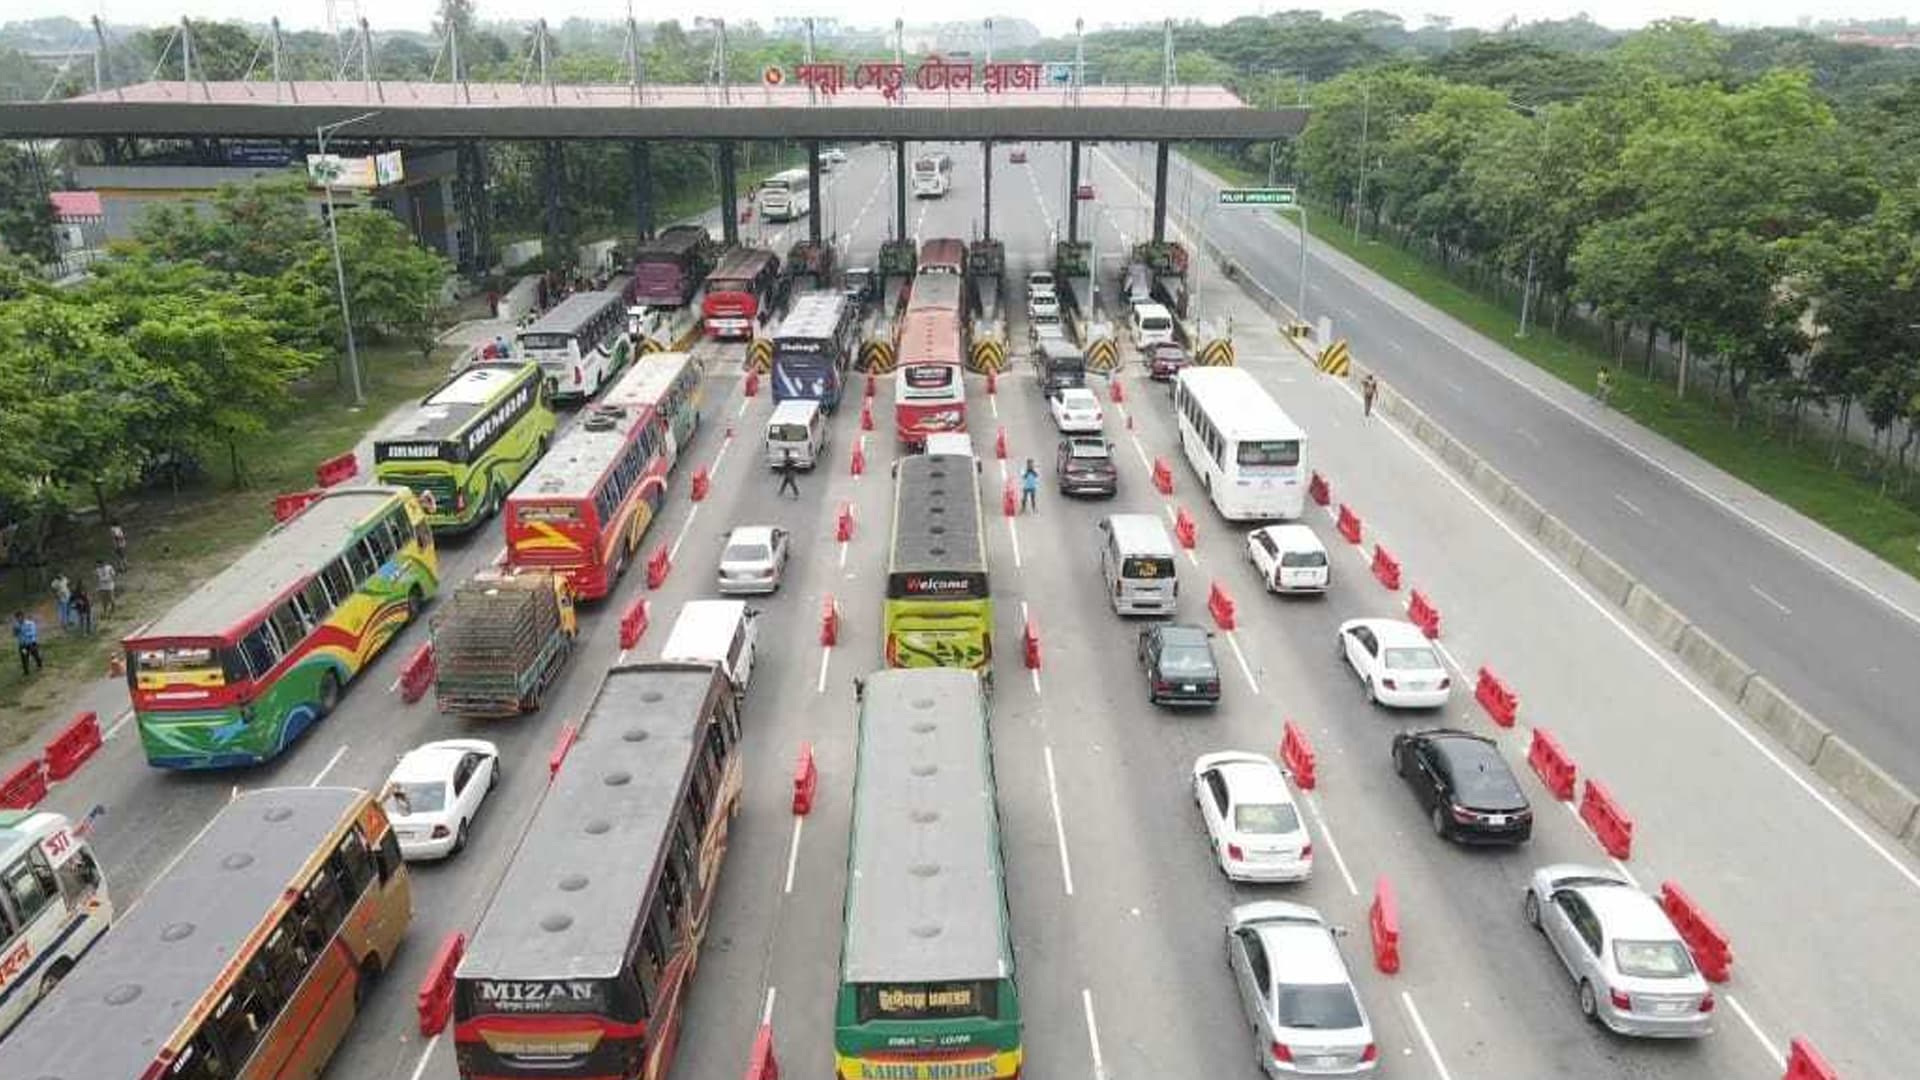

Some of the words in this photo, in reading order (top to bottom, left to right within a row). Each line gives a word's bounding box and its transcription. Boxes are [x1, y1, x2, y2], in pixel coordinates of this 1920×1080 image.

[793, 64, 844, 95] পদ্মা
[855, 63, 904, 99] সেতু
[915, 57, 972, 90] টোল
[983, 64, 1043, 94] প্লাজা
[906, 577, 969, 592] Welcome
[481, 981, 593, 1000] MIZAN
[927, 1060, 997, 1079] MOTORS
